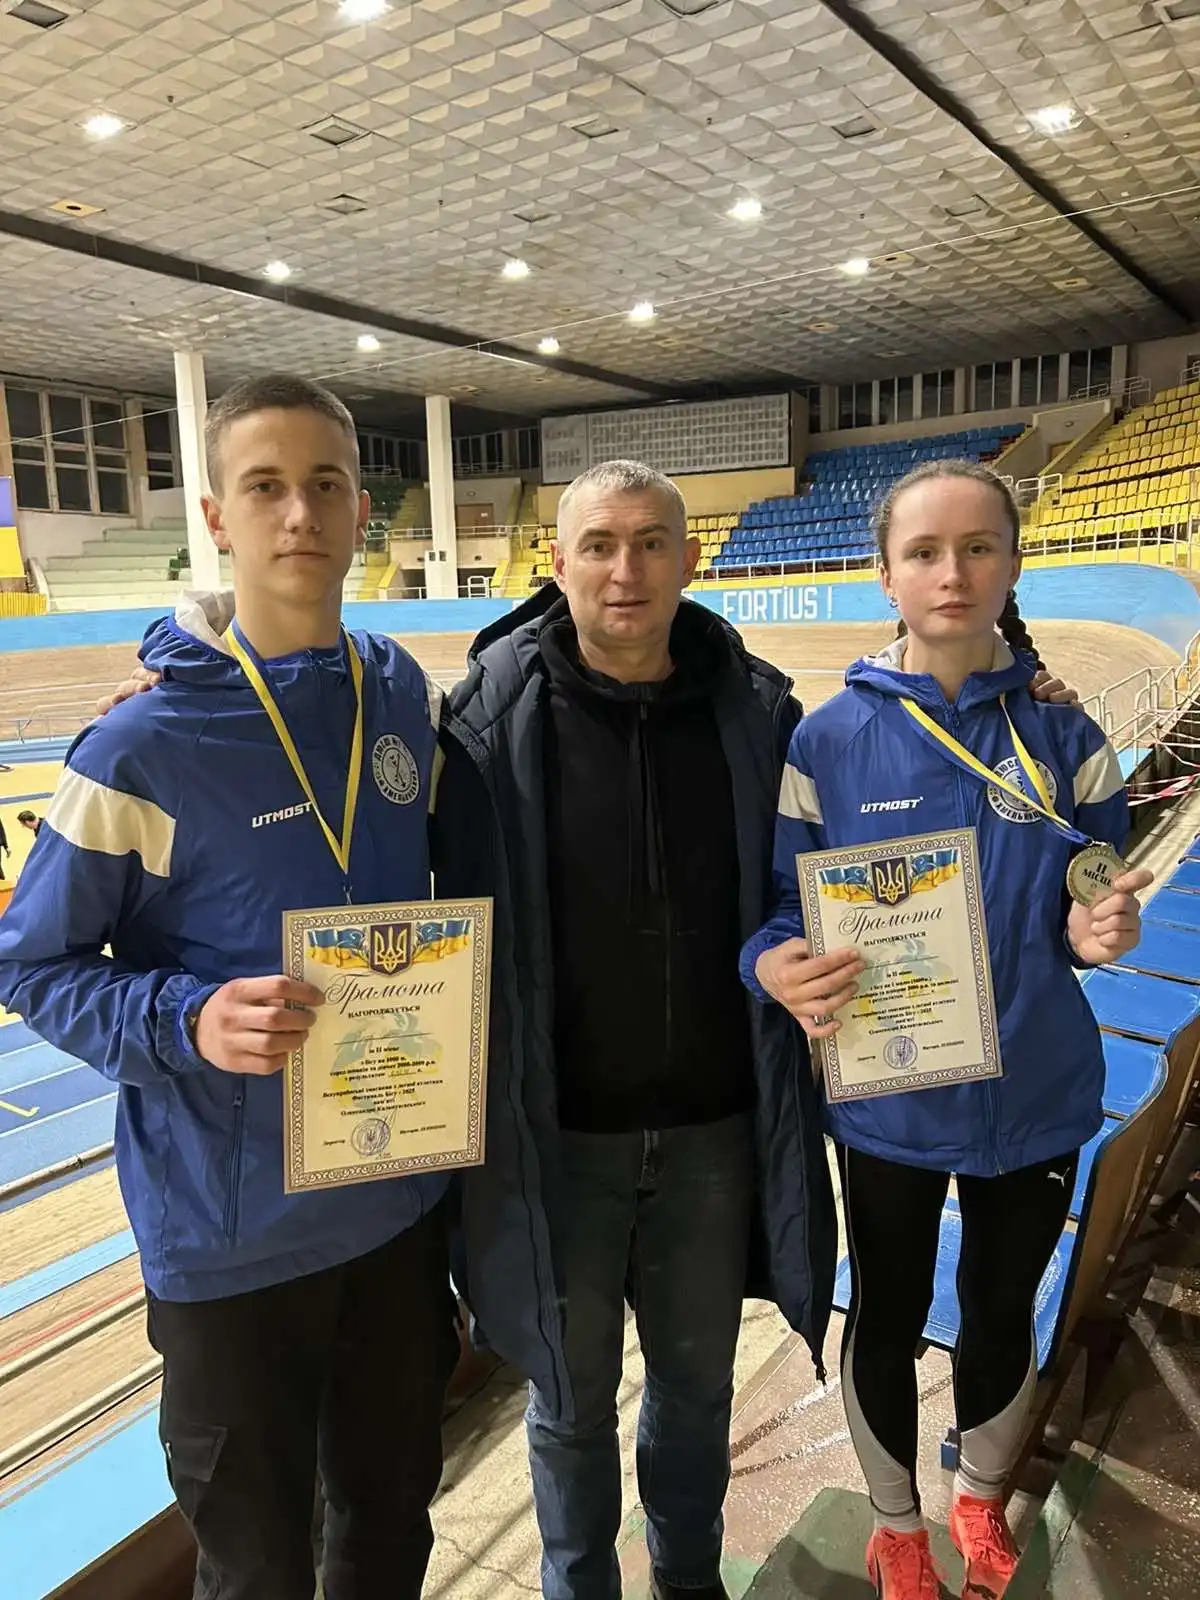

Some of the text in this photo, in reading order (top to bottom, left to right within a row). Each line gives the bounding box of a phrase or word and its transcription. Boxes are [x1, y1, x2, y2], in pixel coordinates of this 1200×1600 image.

[252, 800, 312, 829] UTMOST
[860, 798, 921, 813] UTMOST
[839, 904, 943, 943] Грамота
[325, 972, 446, 1014] Грамота
